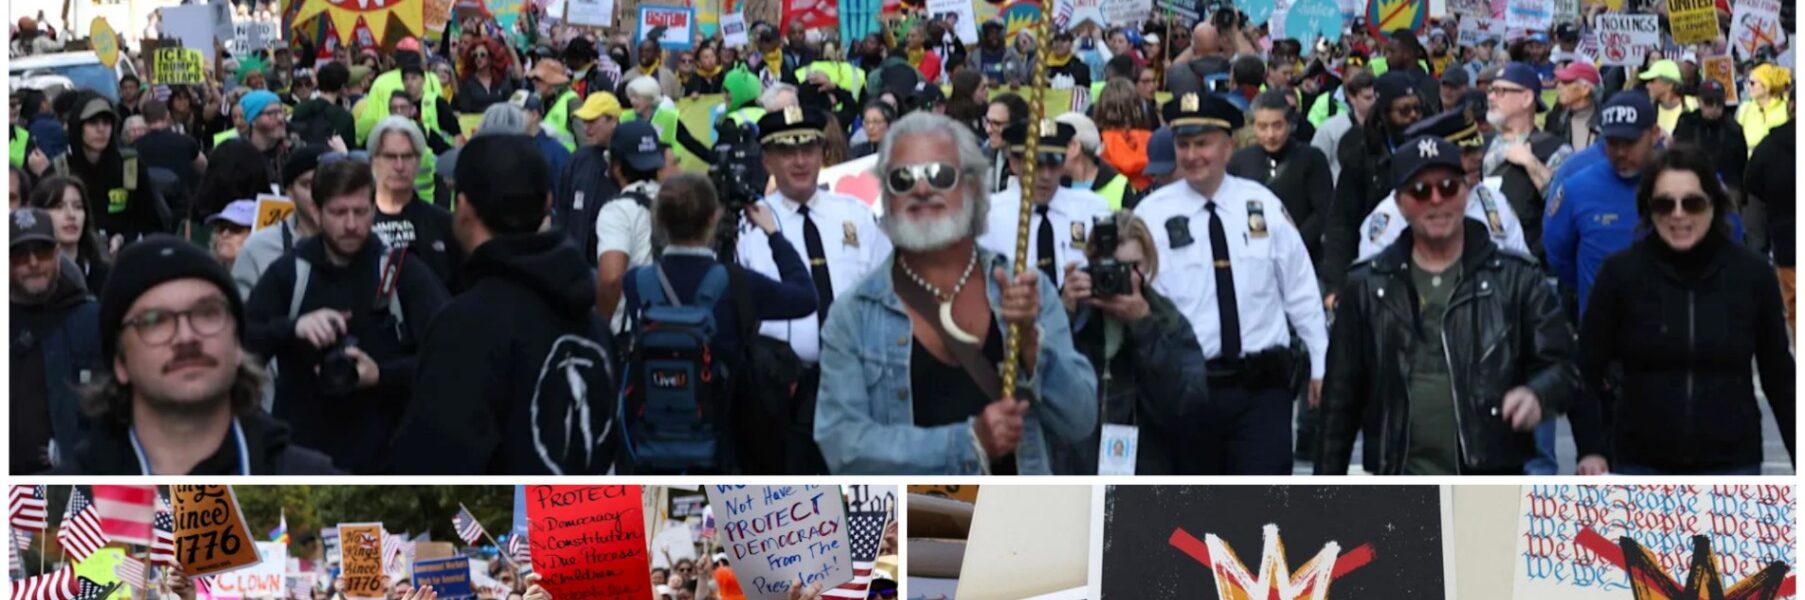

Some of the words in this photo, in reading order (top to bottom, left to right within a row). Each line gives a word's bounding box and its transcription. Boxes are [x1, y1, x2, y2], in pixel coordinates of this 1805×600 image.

[157, 61, 200, 73] TRUMP'S
[159, 49, 187, 61] ICE
[157, 72, 200, 83] GESTAPO
[1601, 105, 1638, 124] NYPD
[532, 485, 626, 509] PROTECT
[726, 494, 753, 519] Not
[764, 485, 797, 505] Have
[724, 493, 824, 542] PROTECT
[1526, 492, 1575, 522] We
[1612, 499, 1701, 537] People
[1706, 509, 1756, 540] We
[176, 525, 241, 564] 1776
[733, 516, 840, 559] DEMOCRACY
[1522, 531, 1571, 562] We
[766, 554, 801, 571] From
[808, 540, 840, 559] The
[1521, 551, 1570, 584] We
[217, 572, 280, 592] CLOWN
[347, 574, 381, 592] 1776
